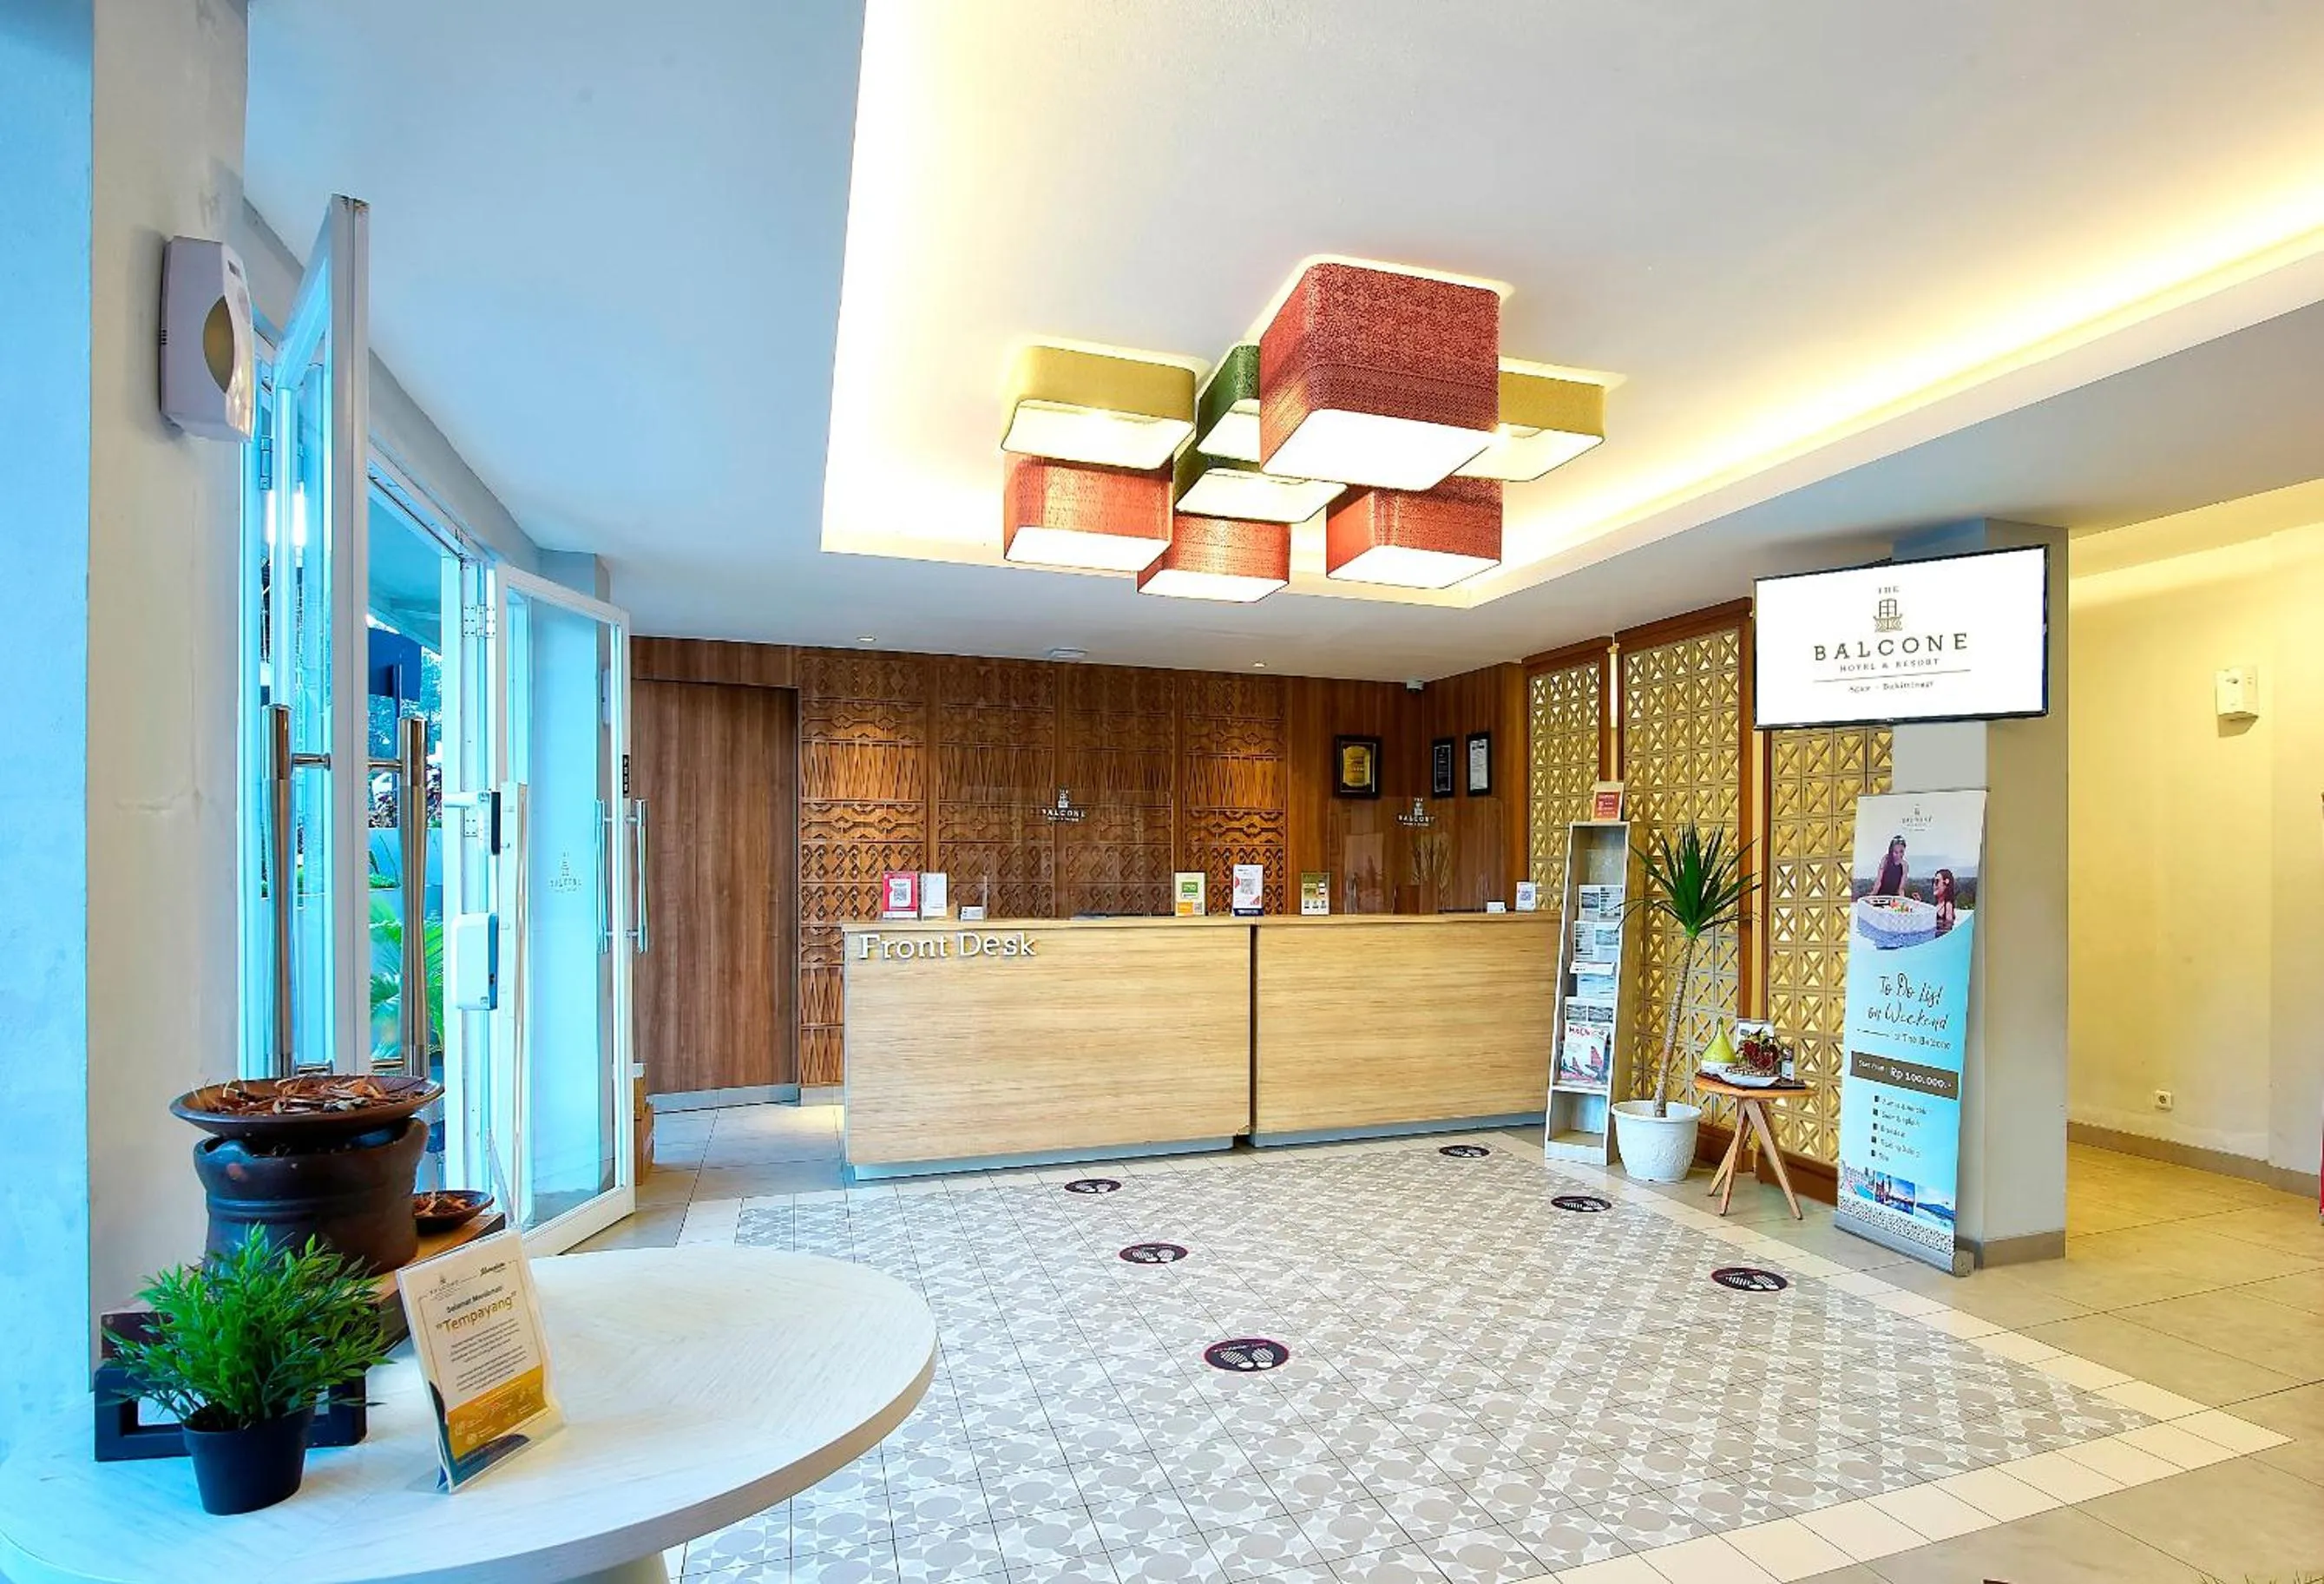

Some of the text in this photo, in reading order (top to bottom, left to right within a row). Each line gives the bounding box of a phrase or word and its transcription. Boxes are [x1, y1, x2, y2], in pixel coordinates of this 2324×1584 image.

[1878, 586, 1900, 595] THE
[1814, 633, 1967, 661] BALCONE
[1840, 662, 1876, 673] HOTEL
[1895, 657, 1940, 668] RESORT
[858, 931, 1038, 960] Front Desk
[1879, 975, 1892, 996] To
